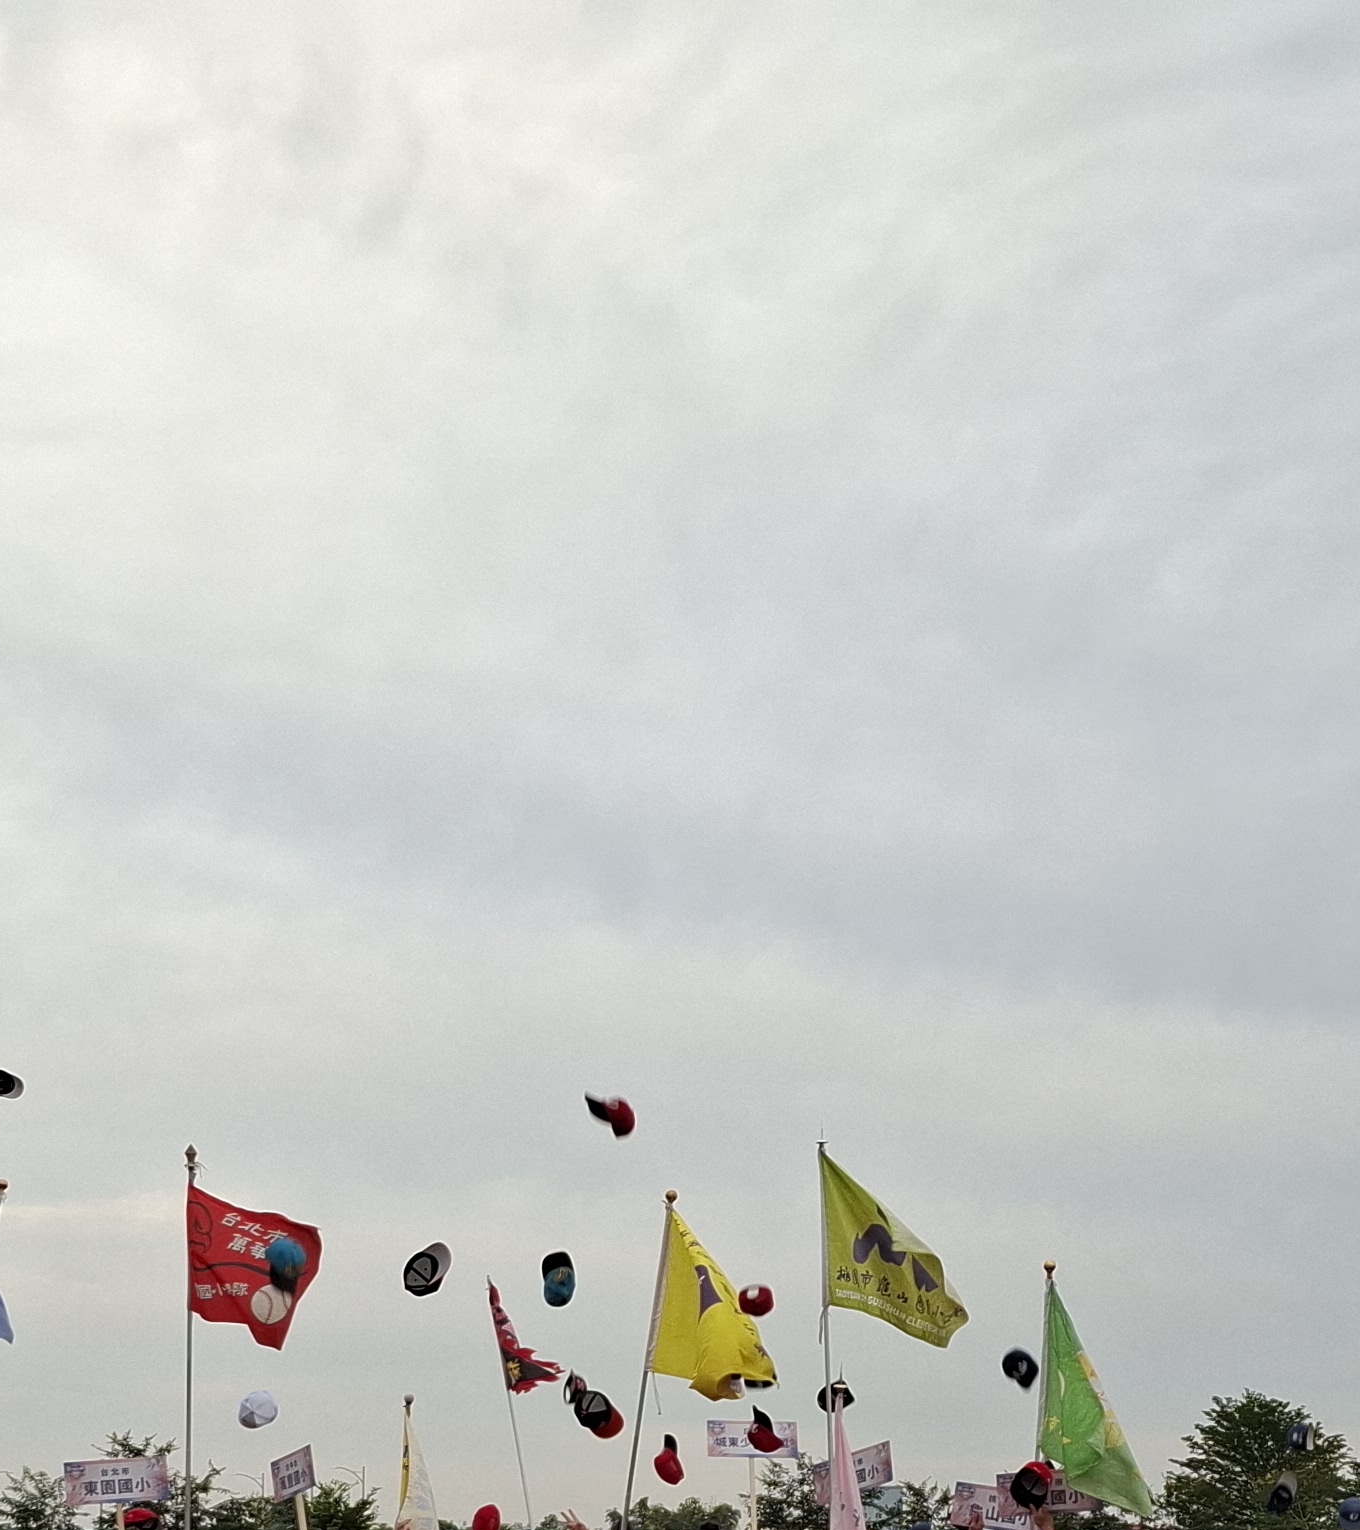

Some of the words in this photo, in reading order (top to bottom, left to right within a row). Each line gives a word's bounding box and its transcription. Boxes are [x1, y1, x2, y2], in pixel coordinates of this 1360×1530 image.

[221, 1212, 289, 1242] 台北市
[227, 1233, 266, 1259] 萬華
[99, 1467, 131, 1477] 台北市
[82, 1475, 151, 1497] 東園國小
